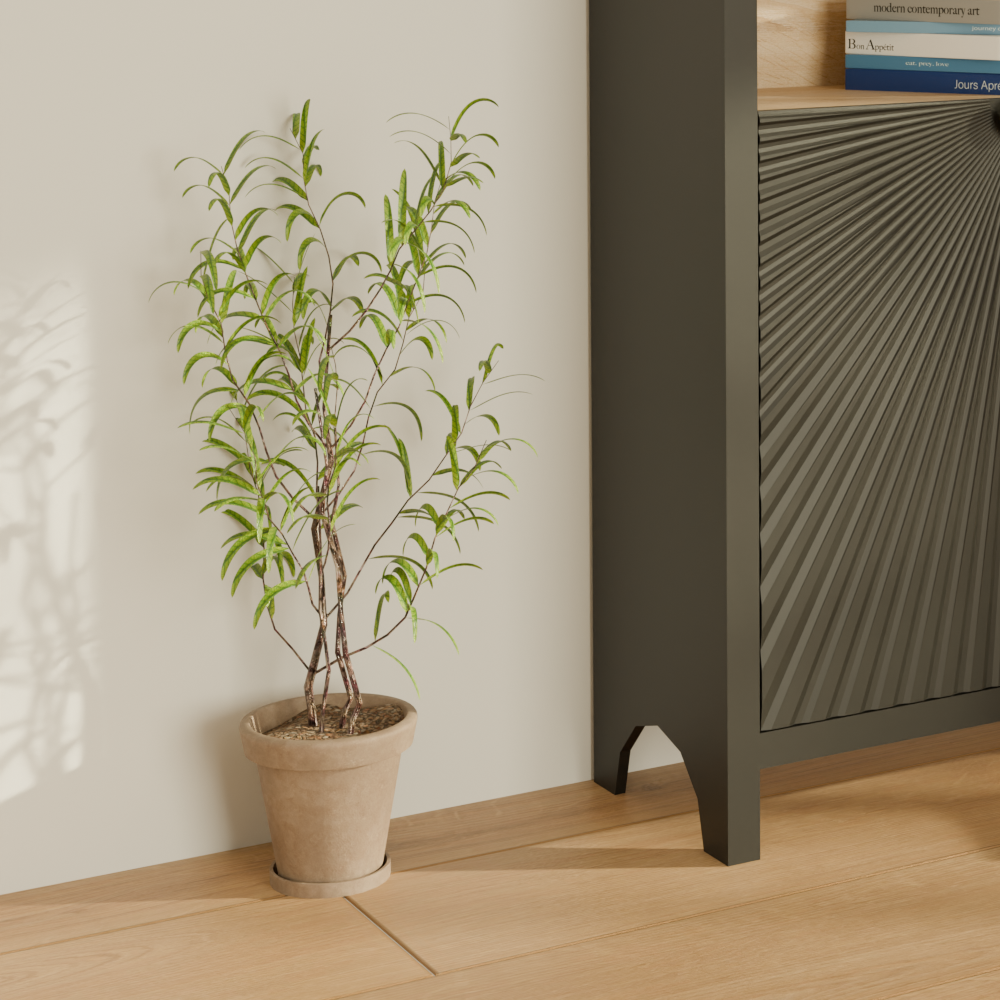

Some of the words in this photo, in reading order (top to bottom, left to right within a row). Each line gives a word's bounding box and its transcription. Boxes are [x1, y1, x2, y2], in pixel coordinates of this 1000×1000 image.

[873, 2, 906, 14] modern
[907, 6, 966, 18] contemporary
[967, 7, 980, 16] art
[971, 25, 997, 33] journey
[848, 38, 865, 50] Bon
[866, 39, 895, 52] Appétit
[954, 79, 979, 90] Jours
